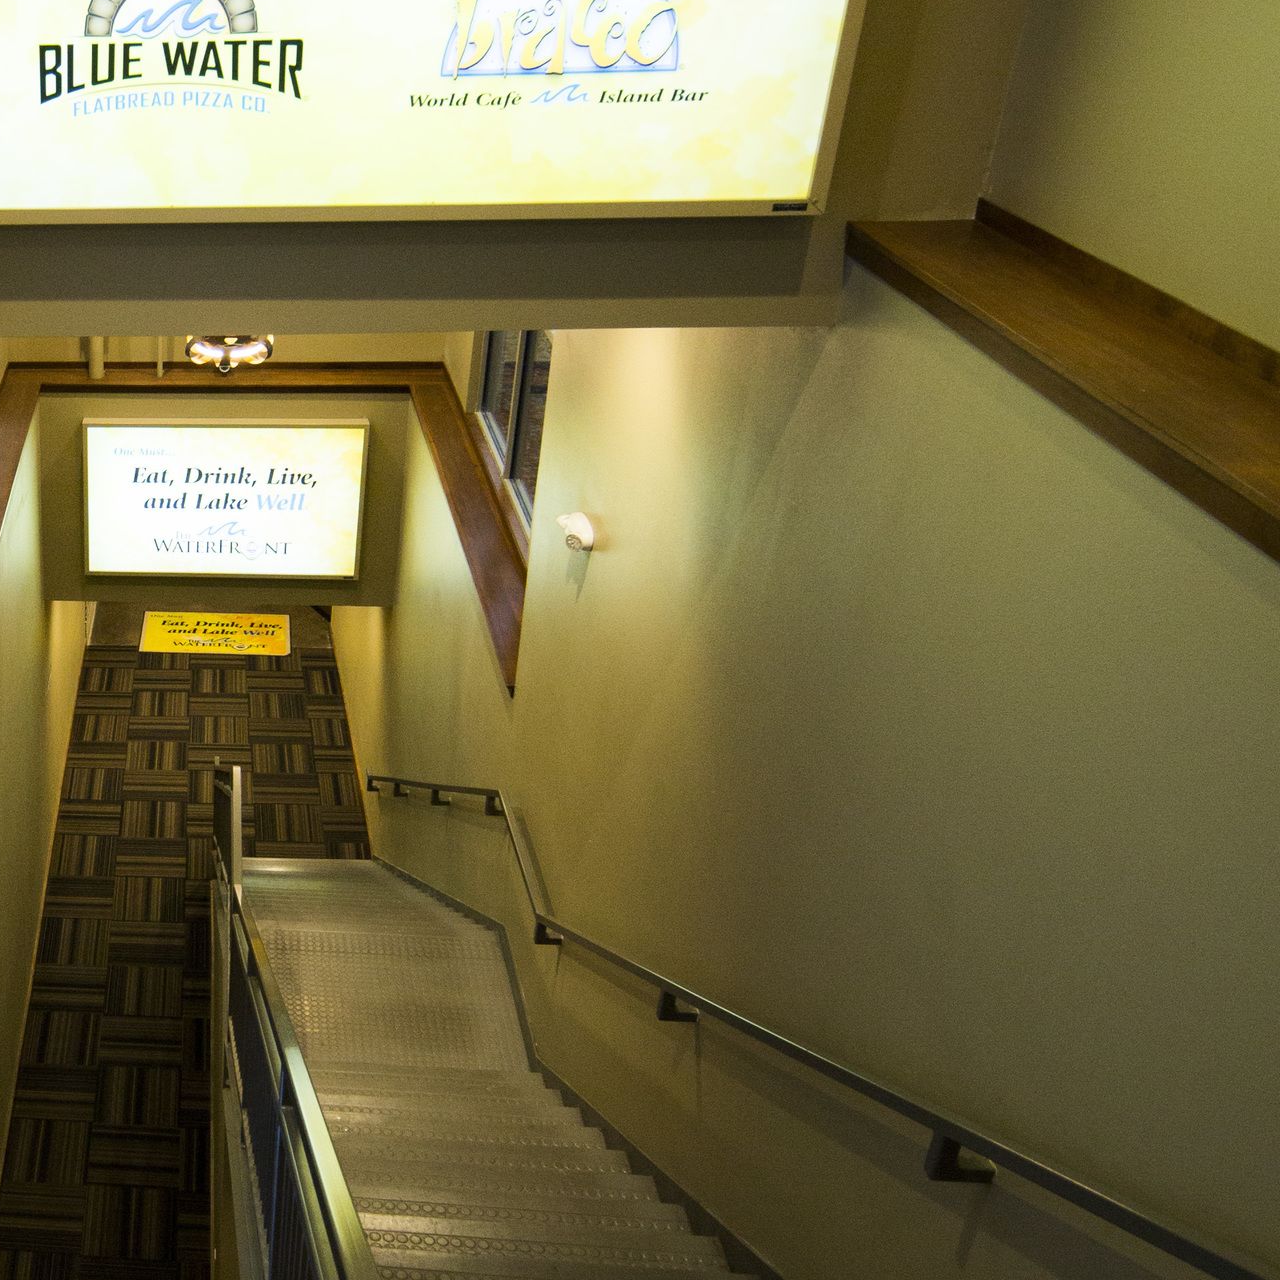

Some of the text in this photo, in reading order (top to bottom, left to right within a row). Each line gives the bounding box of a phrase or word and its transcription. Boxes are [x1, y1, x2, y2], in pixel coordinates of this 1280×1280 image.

[39, 39, 304, 104] BLUE WATER
[73, 91, 174, 117] FLATBREAD
[182, 91, 233, 109] PIZZA
[409, 92, 468, 108] World
[599, 89, 666, 104] Island
[671, 87, 709, 102] Bar
[132, 467, 318, 488] Eat, Drink, Live,
[144, 492, 187, 509] and
[195, 492, 248, 510] Lake
